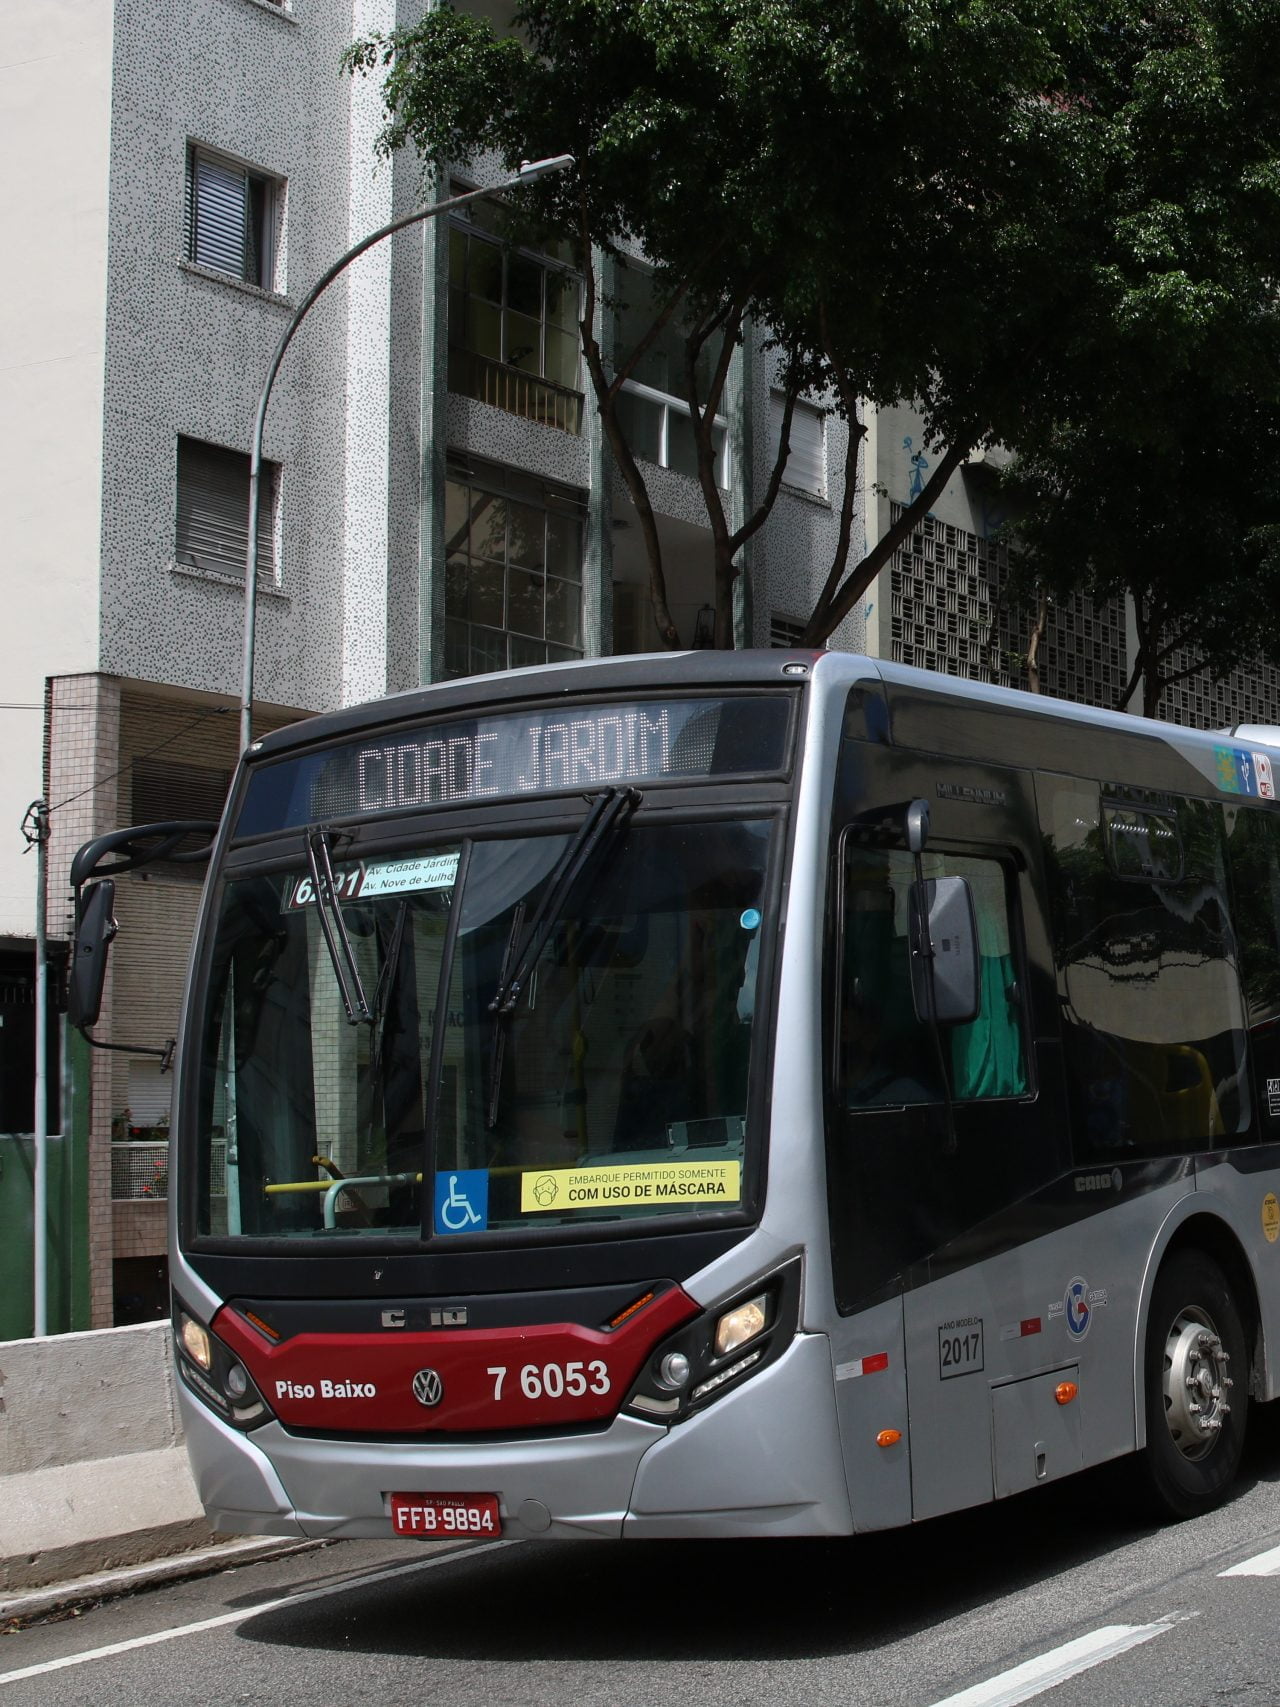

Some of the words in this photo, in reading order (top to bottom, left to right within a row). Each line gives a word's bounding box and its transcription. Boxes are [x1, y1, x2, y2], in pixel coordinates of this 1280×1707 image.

[359, 733, 498, 810] CIDADE
[519, 709, 669, 790] JARDIM
[367, 867, 382, 876] Av.
[385, 861, 421, 874] Cidade
[423, 857, 459, 869] Jardim
[362, 881, 377, 891] Av.
[380, 878, 407, 889] Nove
[409, 876, 422, 885] de
[424, 872, 453, 883] Julho
[568, 1173, 621, 1186] EMBARQUE
[623, 1170, 676, 1182] PERMITIDO
[678, 1168, 727, 1179] SOMENTE
[568, 1188, 599, 1202] COM
[602, 1186, 631, 1199] USO
[634, 1184, 651, 1197] DE
[656, 1181, 726, 1197] MÁSCARA
[943, 1320, 956, 1330] ANO
[956, 1316, 979, 1328] MODELO
[942, 1333, 980, 1366] 2017
[275, 1380, 316, 1400] Piso
[321, 1379, 376, 1399] Baixo
[486, 1366, 508, 1401] 7
[519, 1360, 611, 1400] 6053
